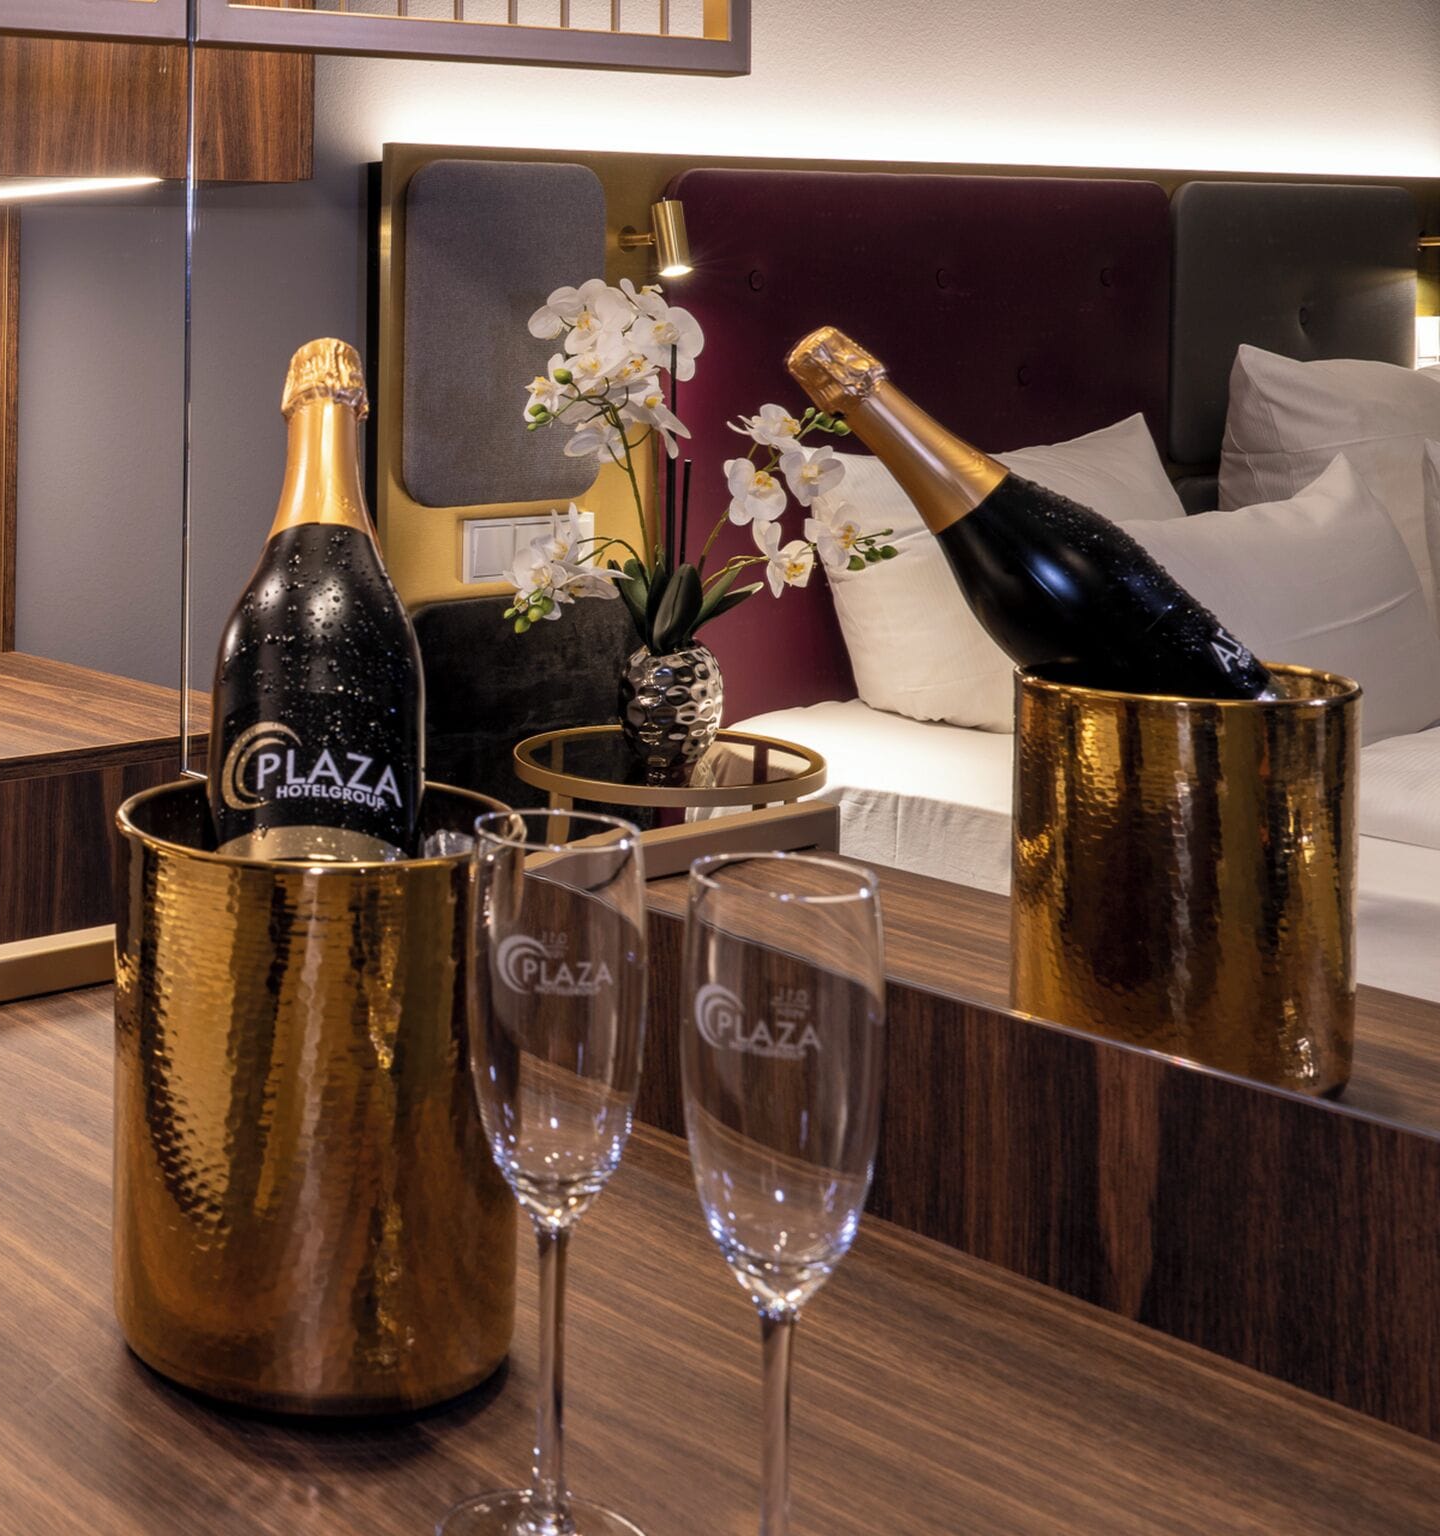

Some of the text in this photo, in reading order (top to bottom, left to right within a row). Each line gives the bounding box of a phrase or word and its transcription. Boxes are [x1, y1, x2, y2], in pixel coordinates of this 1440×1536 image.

[257, 748, 403, 808] PLAZA
[276, 783, 387, 810] HOTELGROUP
[522, 957, 613, 987] PLAZA
[717, 1010, 823, 1051] PLAZA
